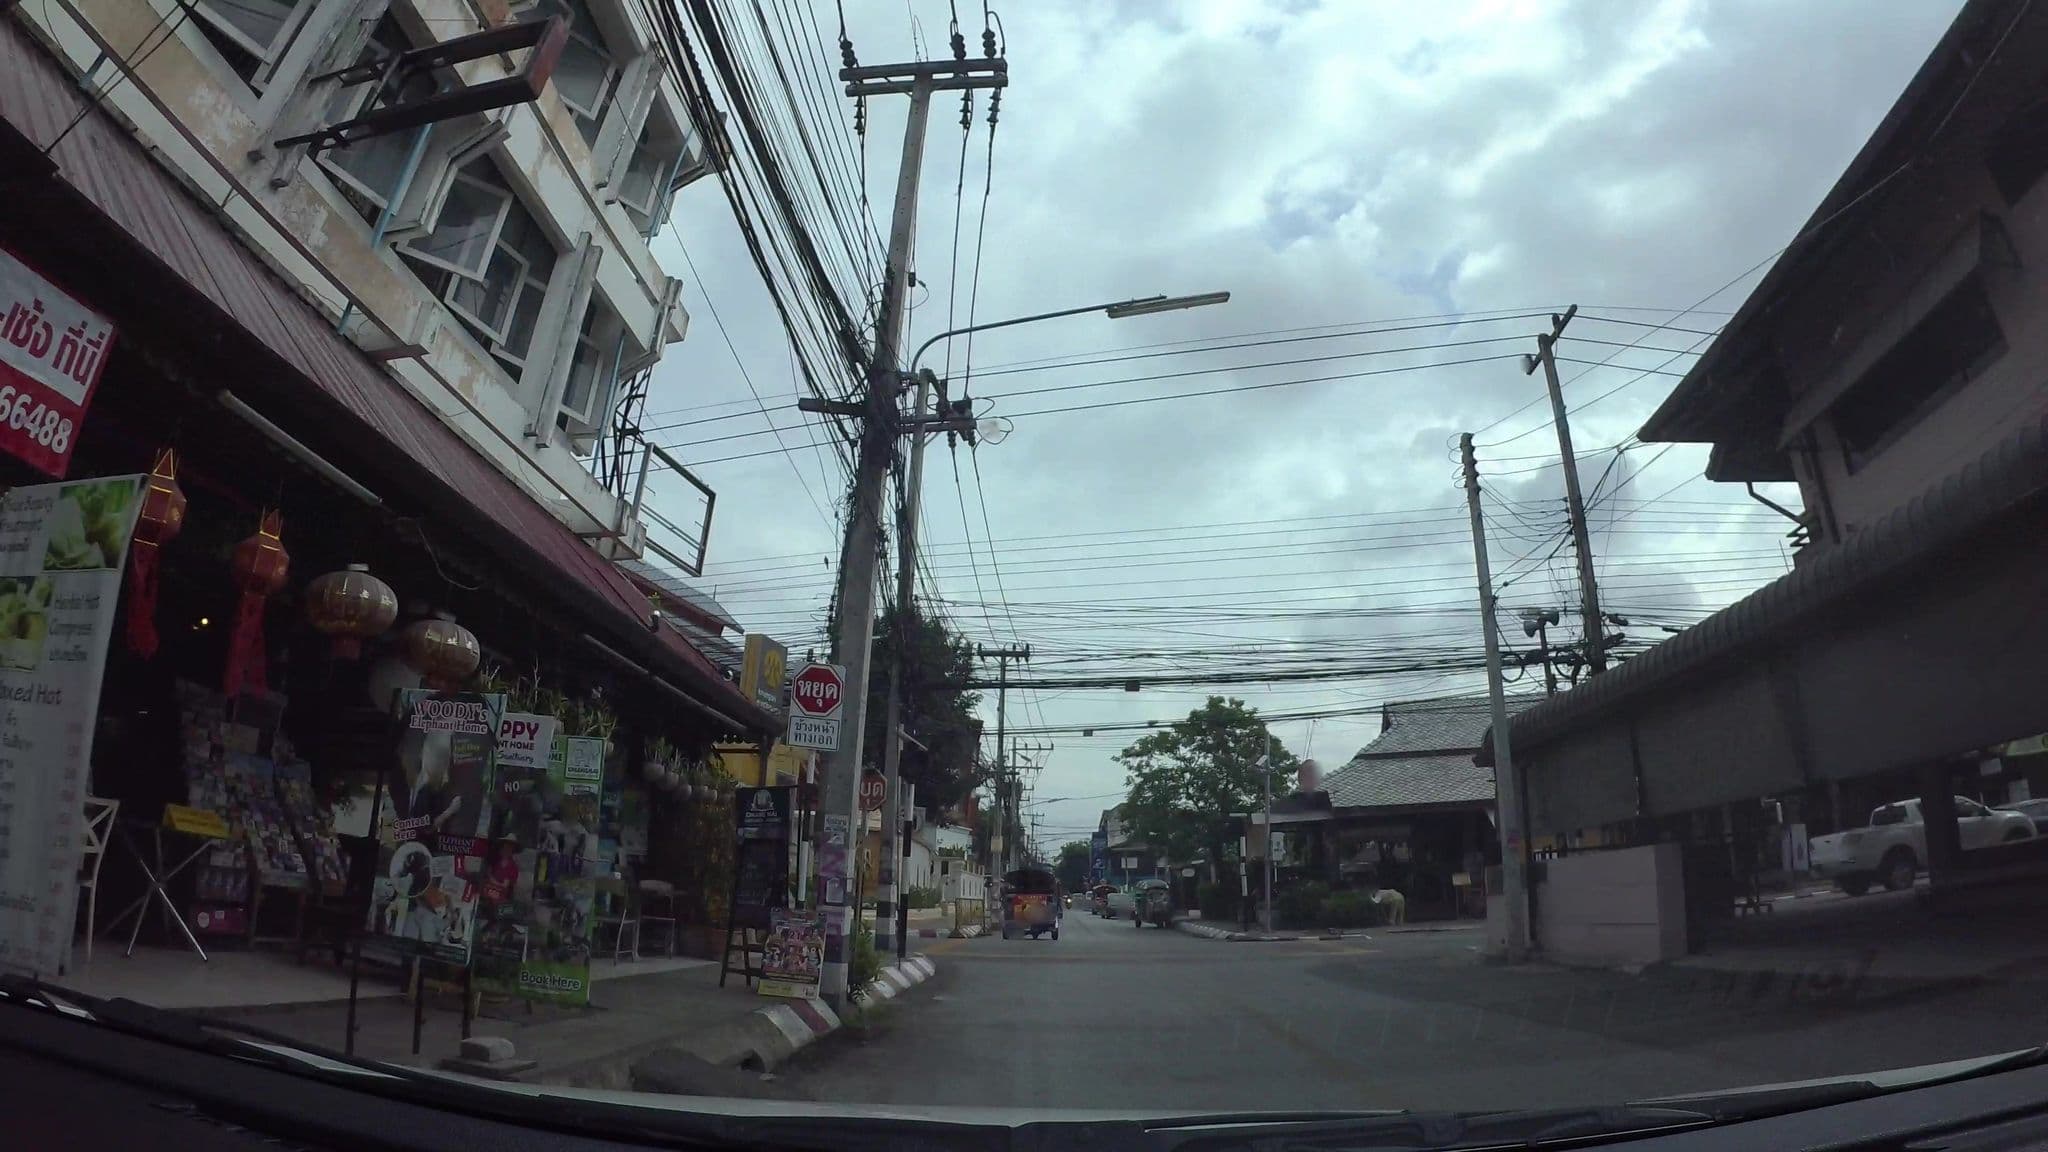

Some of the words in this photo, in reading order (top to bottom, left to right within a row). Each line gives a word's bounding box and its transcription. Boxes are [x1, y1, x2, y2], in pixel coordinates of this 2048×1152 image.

[798, 680, 838, 707] หยุด
[410, 714, 454, 733] Elephant
[455, 719, 488, 733] Home
[500, 720, 539, 740] PPY
[795, 719, 835, 734] ข้างหน้า
[510, 741, 535, 750] HOME
[795, 731, 832, 745] ทางเอก
[504, 780, 520, 793] NO
[393, 813, 430, 831] Contact
[553, 975, 582, 991] Here
